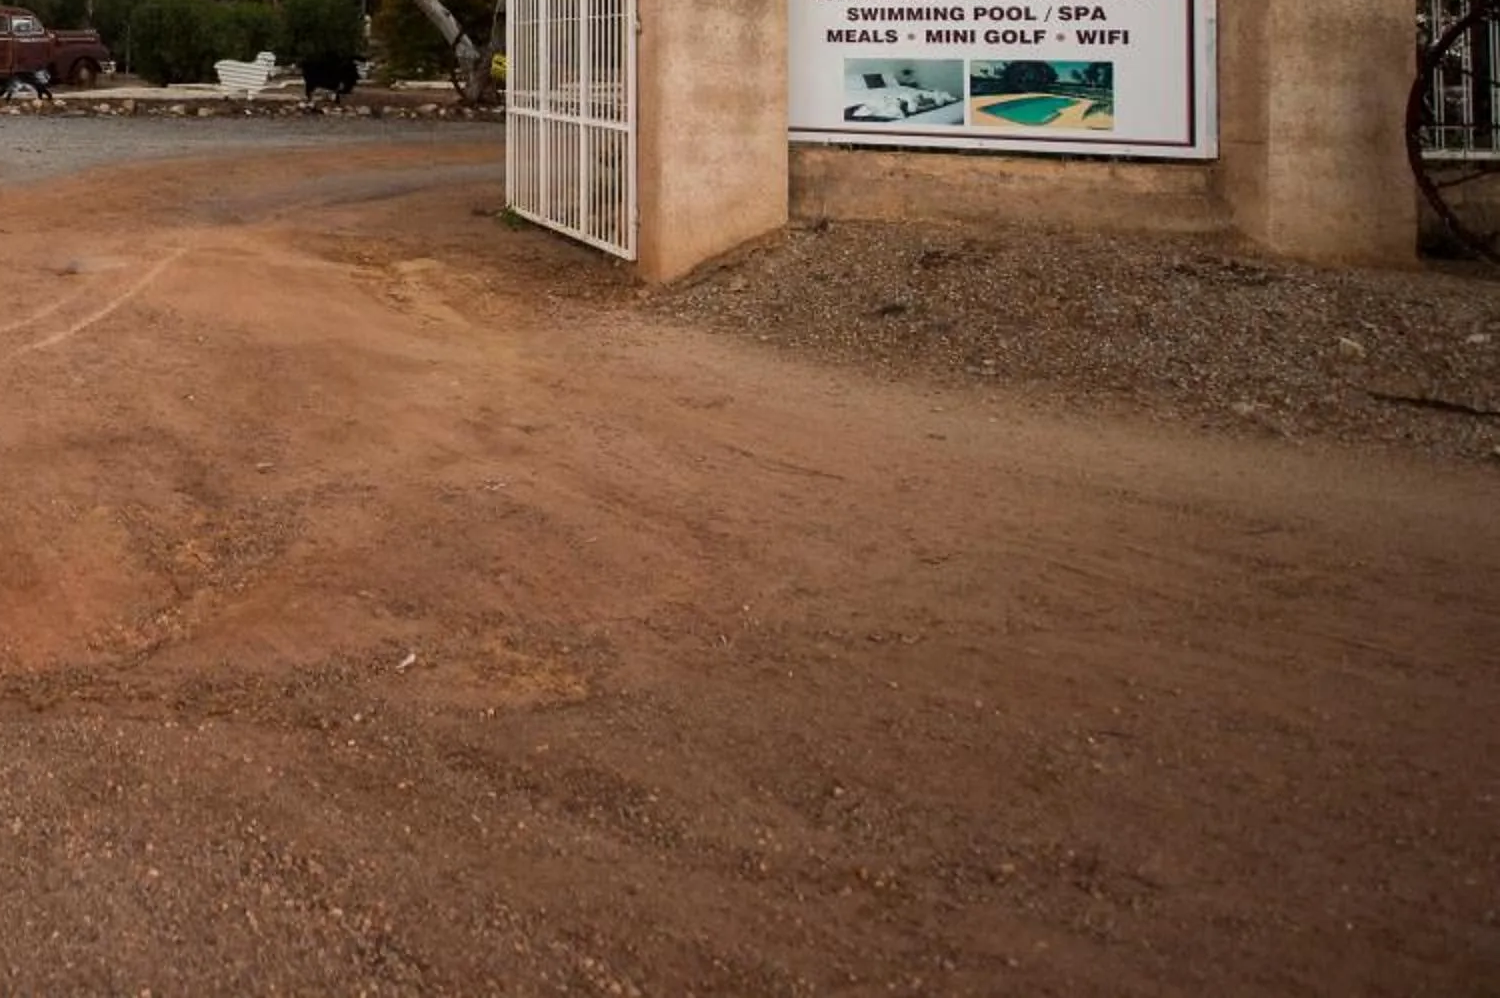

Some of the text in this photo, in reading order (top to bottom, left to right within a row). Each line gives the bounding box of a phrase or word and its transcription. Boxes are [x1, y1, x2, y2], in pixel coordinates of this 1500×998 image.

[846, 6, 966, 22] SWIMMING
[973, 6, 1038, 22] POOL
[1057, 6, 1107, 21] SPA
[826, 29, 1130, 45] MEALS MINI GOLF WIFI
